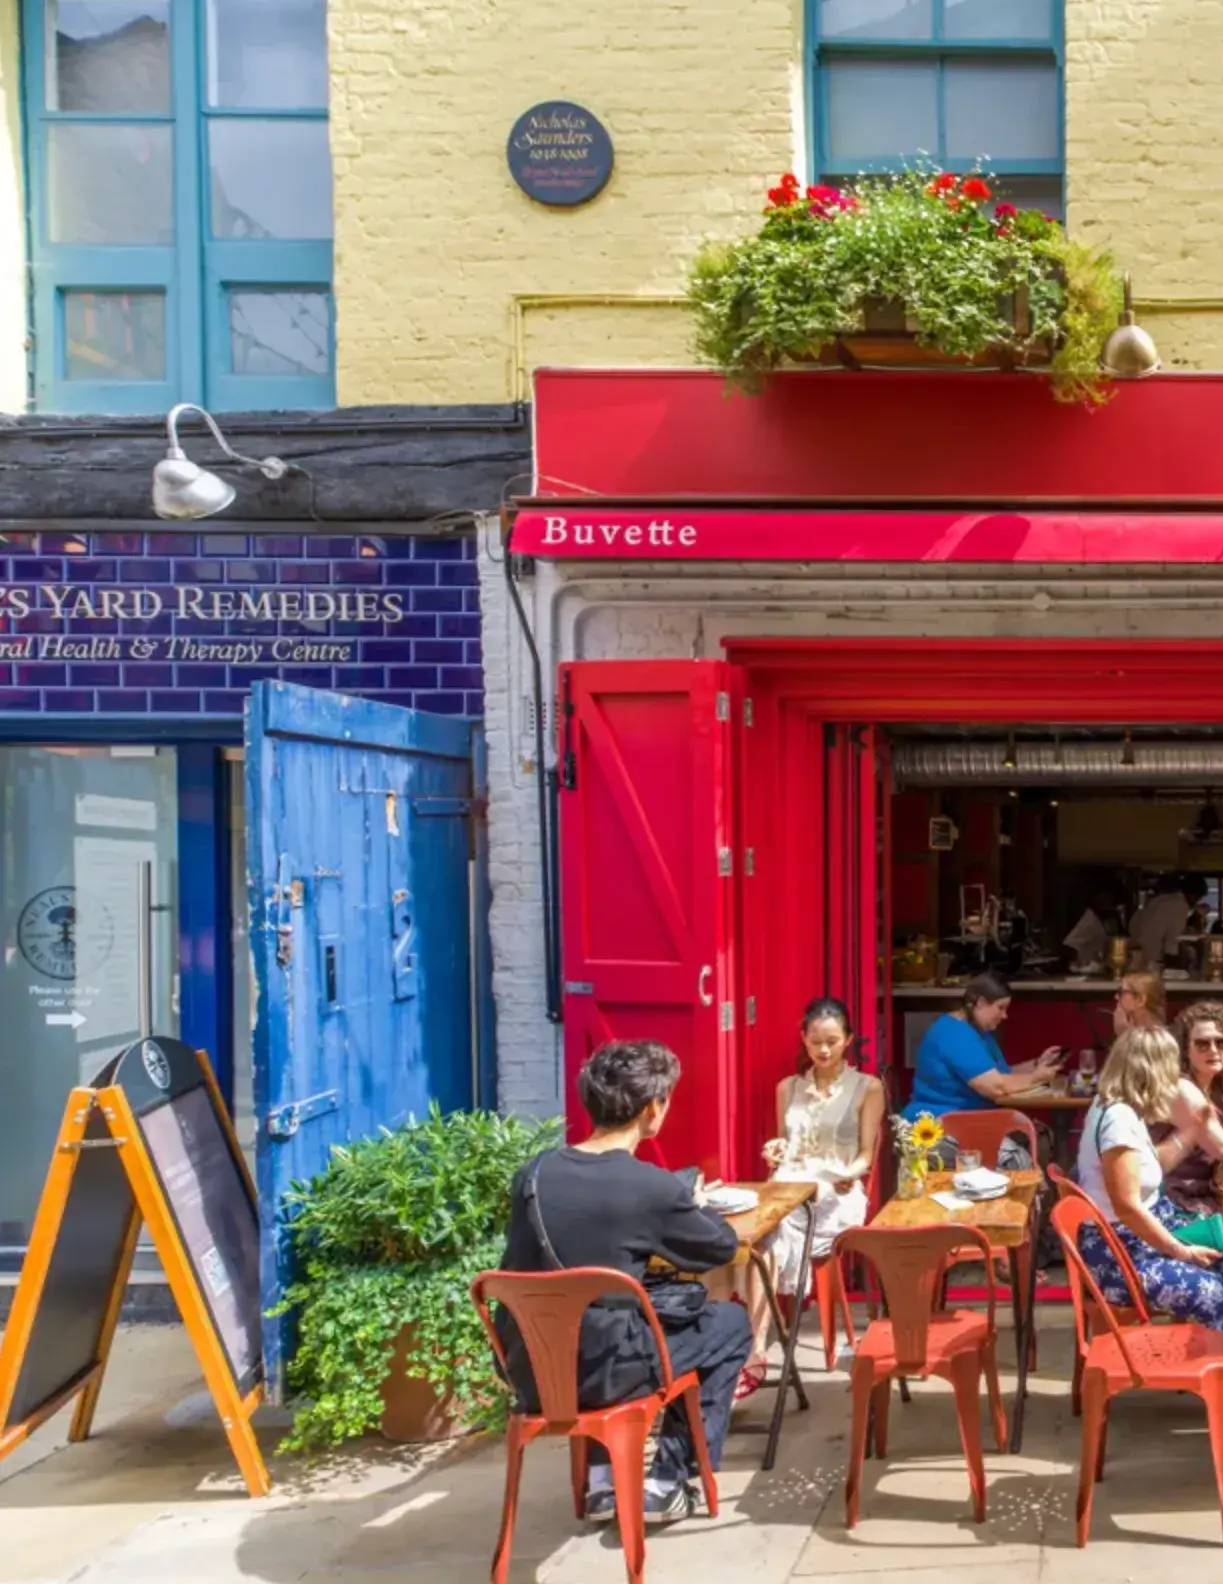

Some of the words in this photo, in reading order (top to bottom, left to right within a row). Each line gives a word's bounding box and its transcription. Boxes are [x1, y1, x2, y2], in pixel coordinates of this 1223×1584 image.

[541, 516, 697, 545] Buvette
[40, 585, 162, 620] YARD
[175, 586, 403, 622] REMEDIES
[40, 636, 121, 660] Health
[129, 638, 159, 660] &
[163, 637, 263, 665] Therapy
[270, 638, 352, 662] Centre
